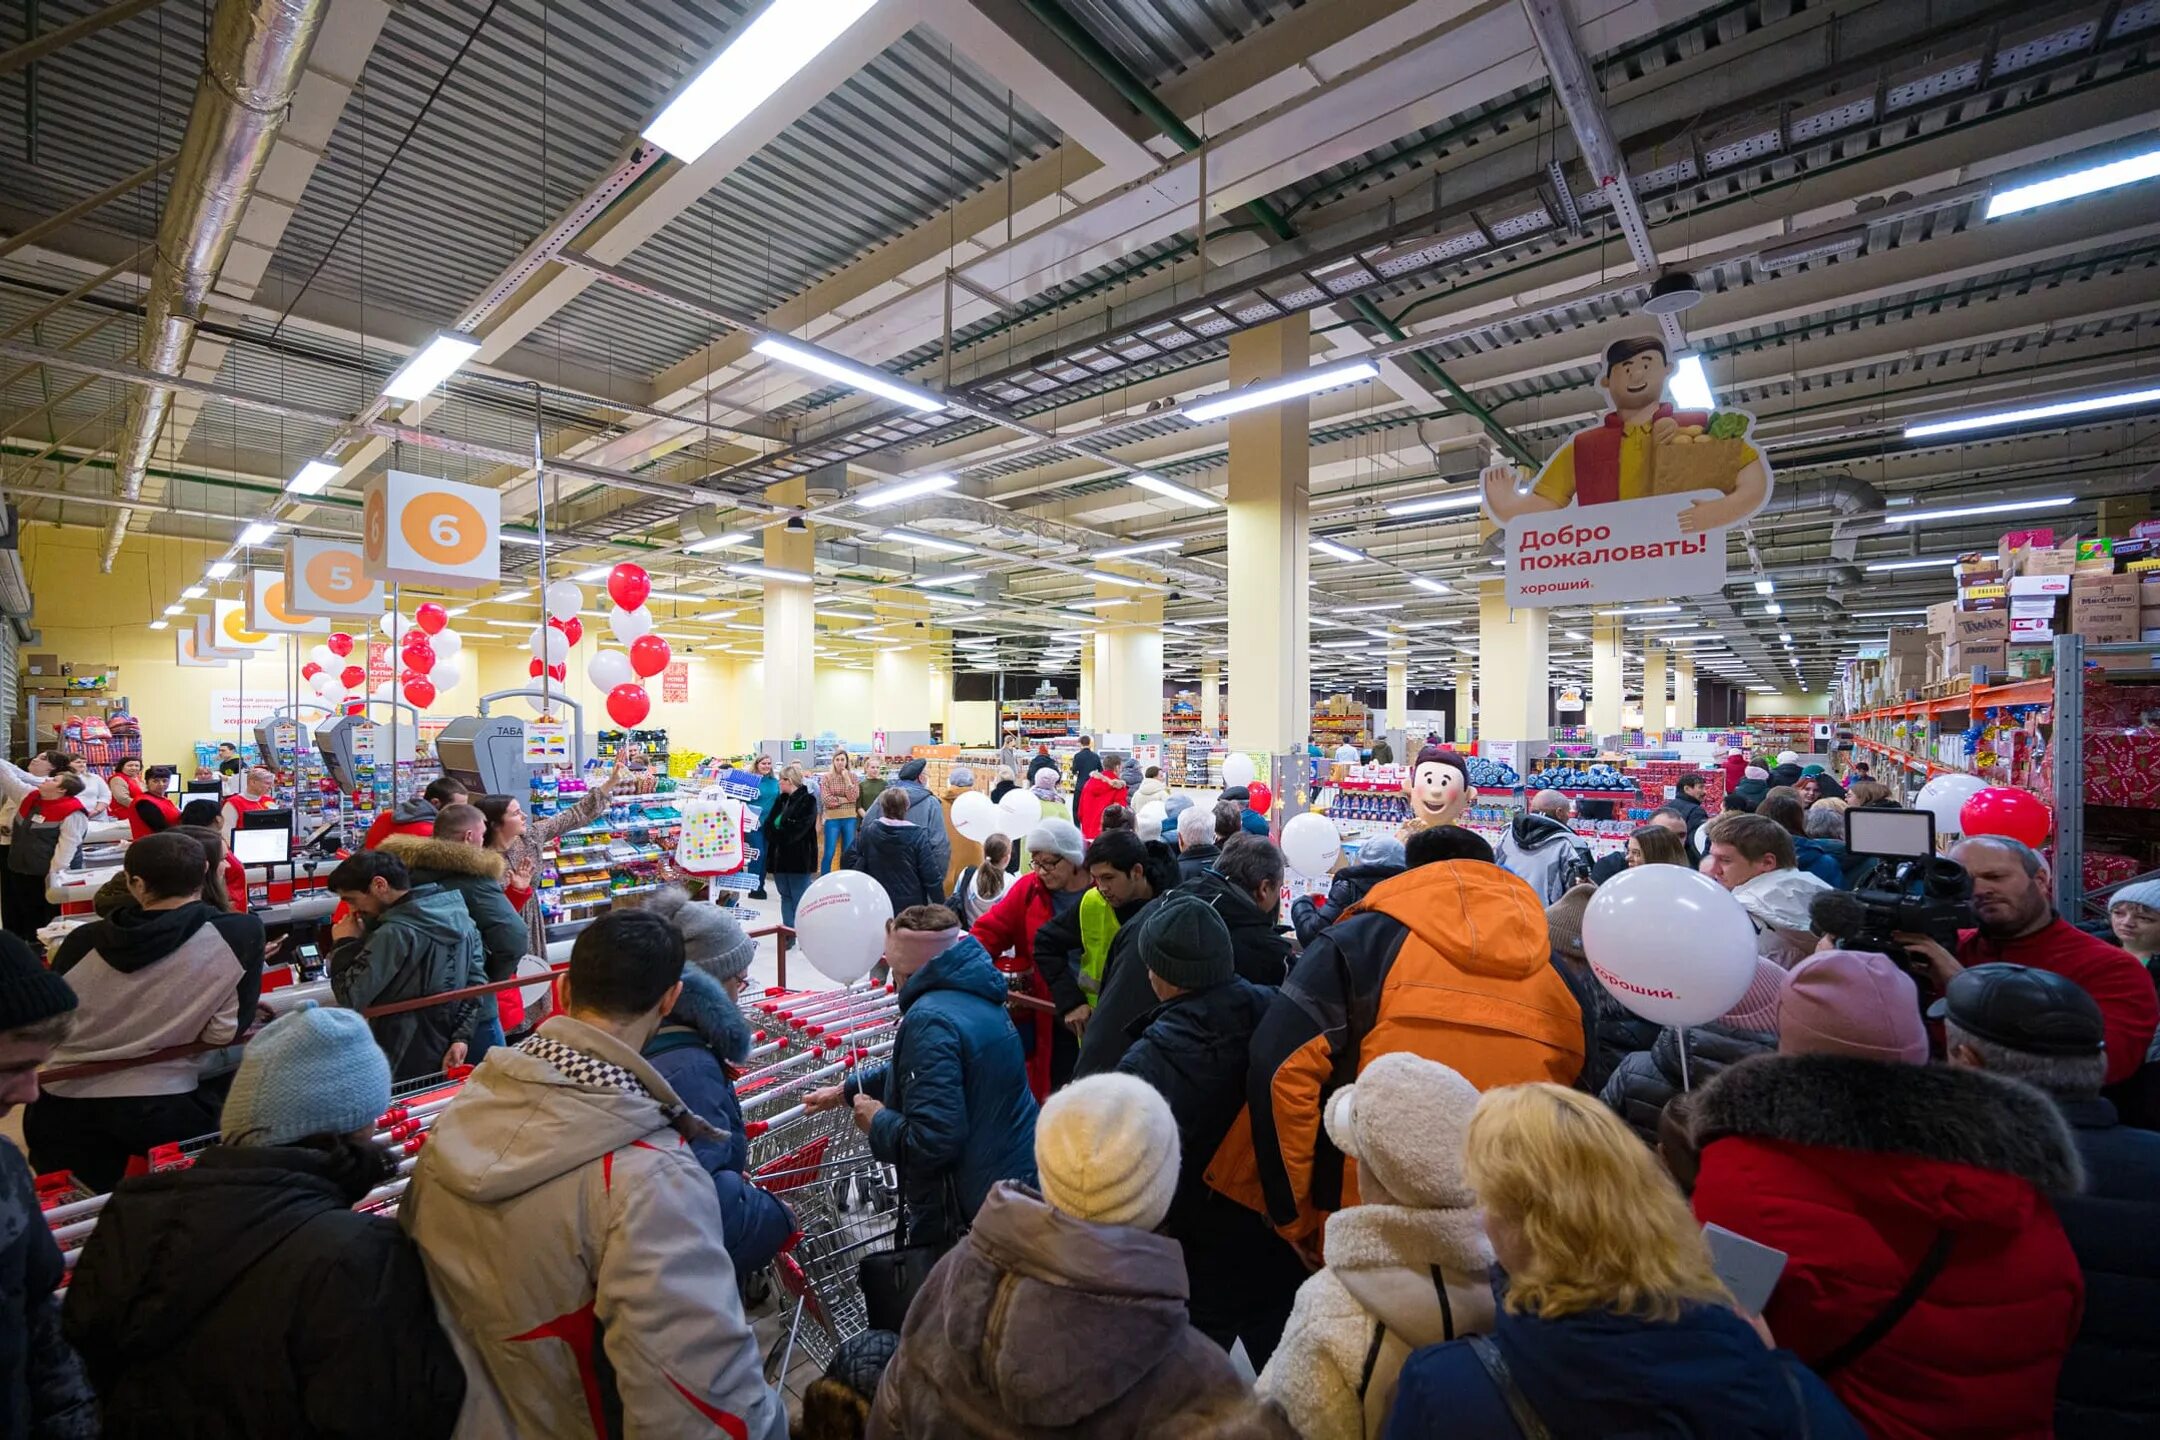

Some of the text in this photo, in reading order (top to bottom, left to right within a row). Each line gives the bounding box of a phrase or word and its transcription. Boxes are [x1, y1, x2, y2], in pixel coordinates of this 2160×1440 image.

[371, 511, 380, 544] 6
[429, 513, 461, 547] 6
[1519, 524, 1611, 552] Добро
[1519, 533, 1707, 571] пожаловать!
[328, 566, 353, 590] 5
[496, 726, 523, 735] ТАБА
